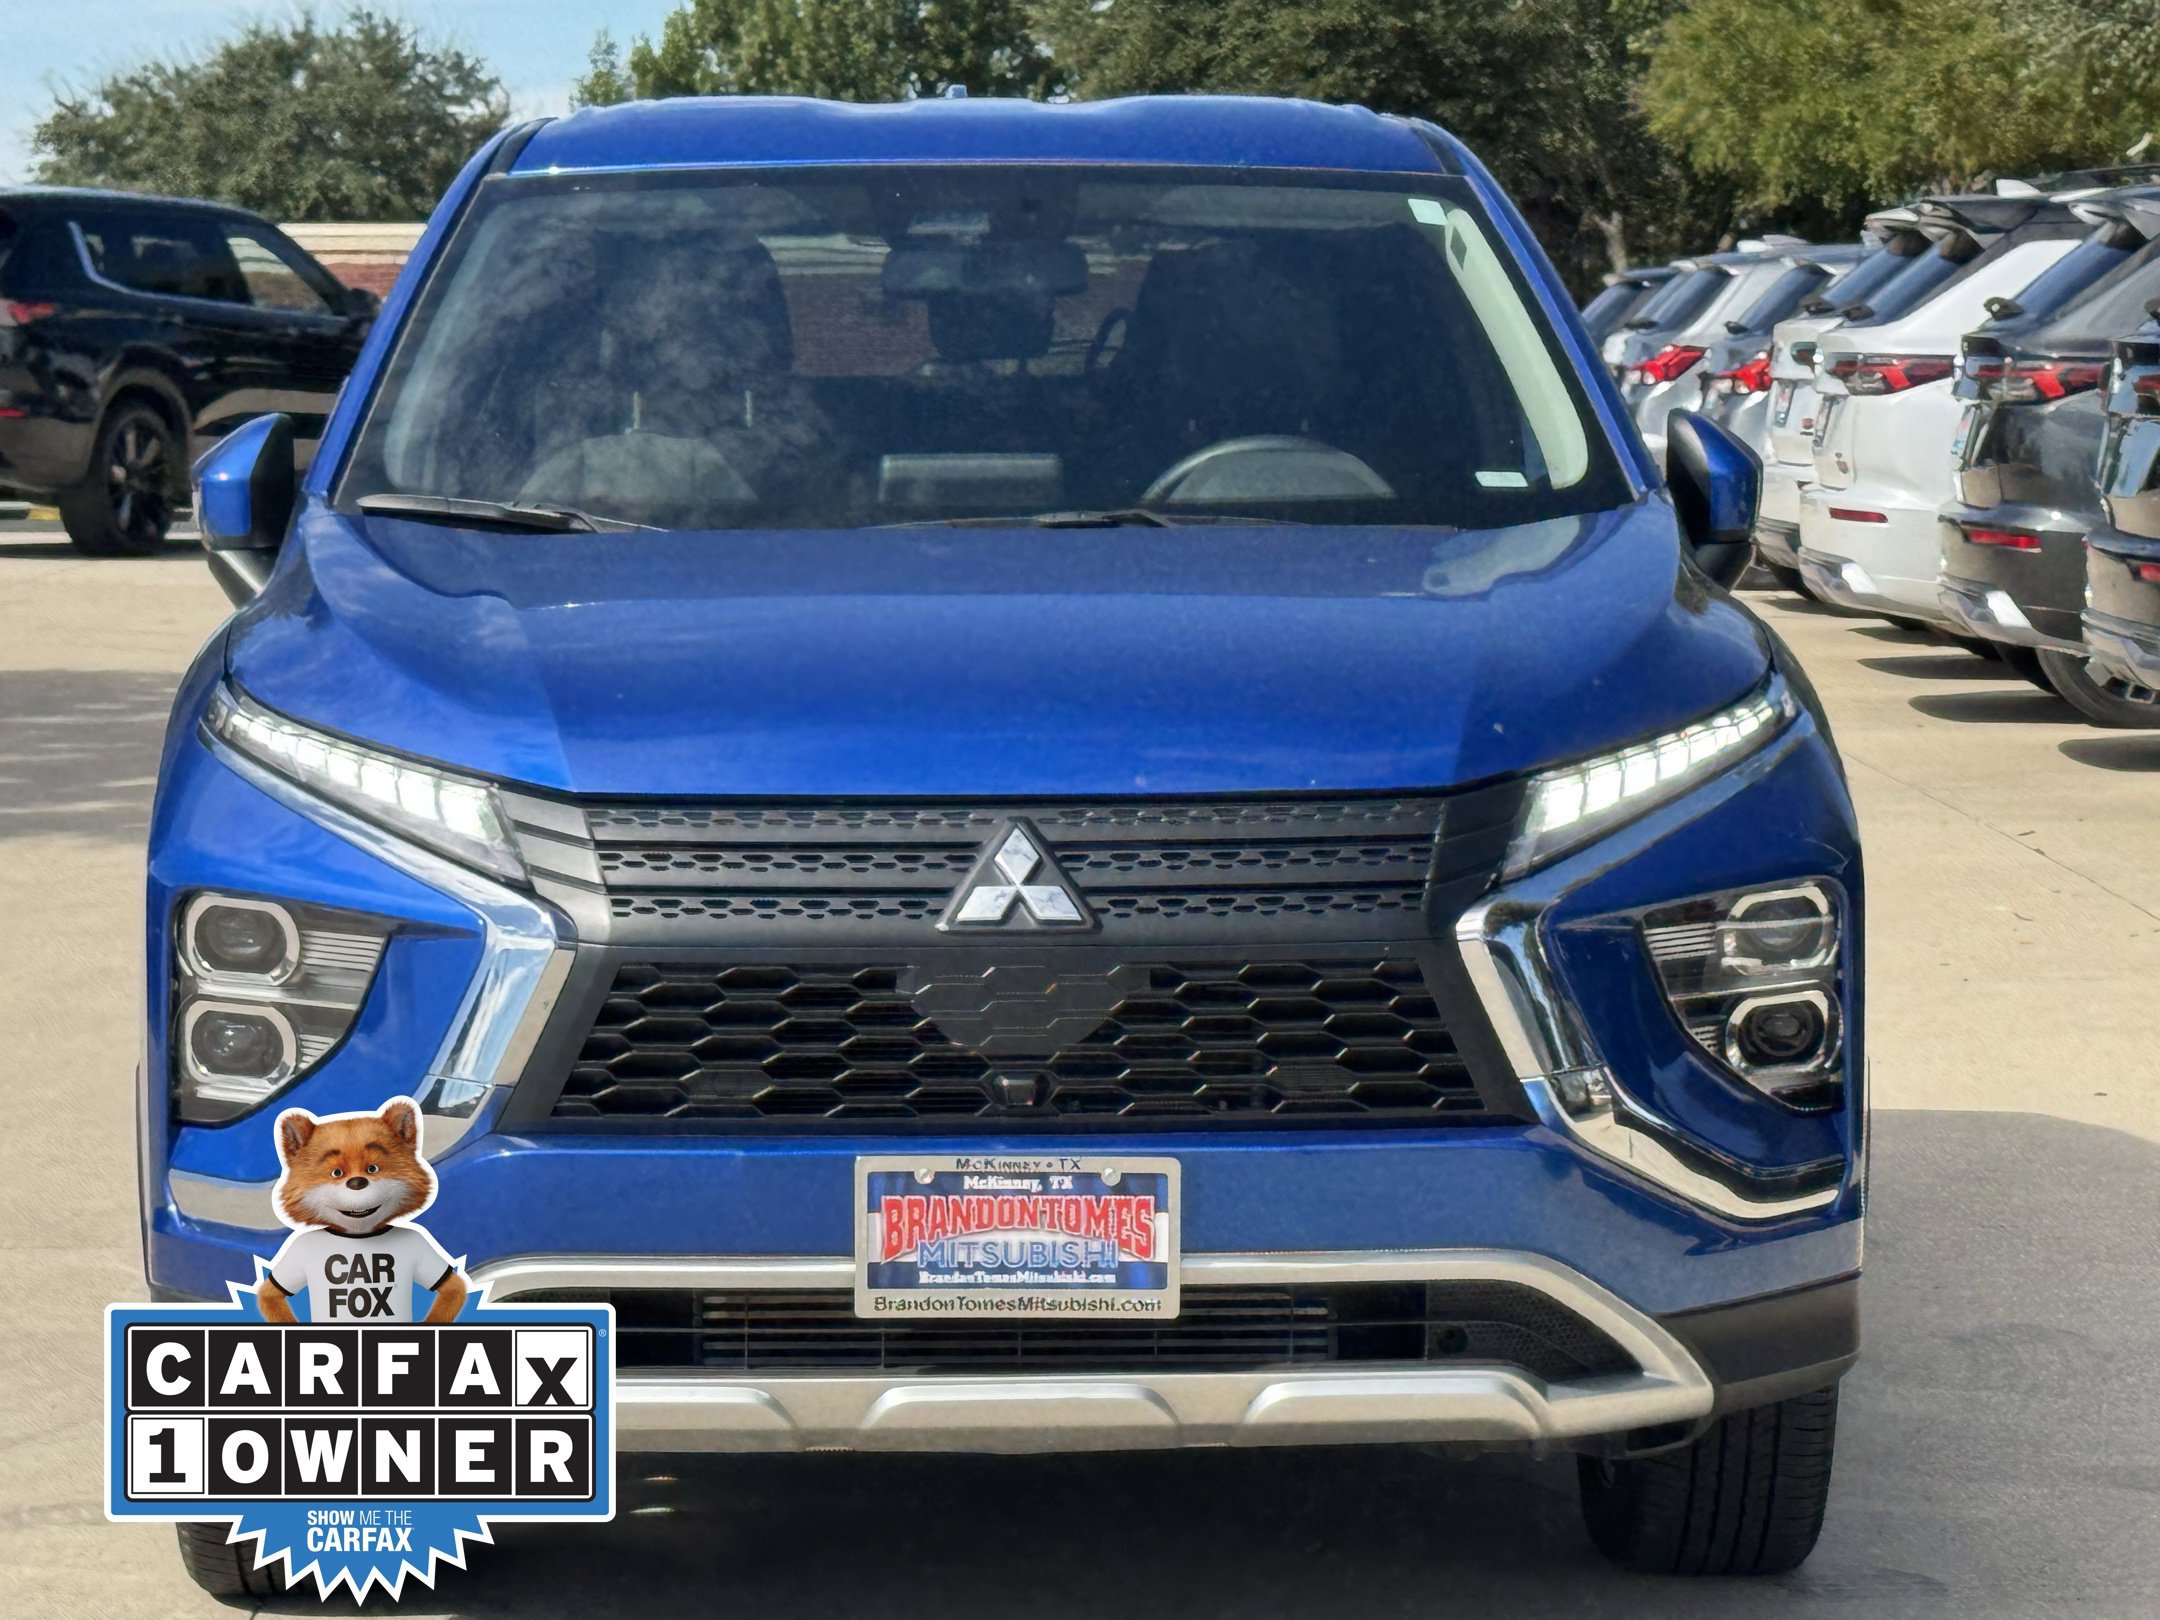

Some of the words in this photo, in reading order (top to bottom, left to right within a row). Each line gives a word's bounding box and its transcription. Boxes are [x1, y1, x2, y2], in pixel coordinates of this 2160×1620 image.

[1059, 1158, 1081, 1170] TX
[1049, 1175, 1073, 1189] TX
[917, 1240, 1119, 1268] MITSUBISHI
[874, 1296, 1162, 1312] BrandonTomesMitsubishi.com
